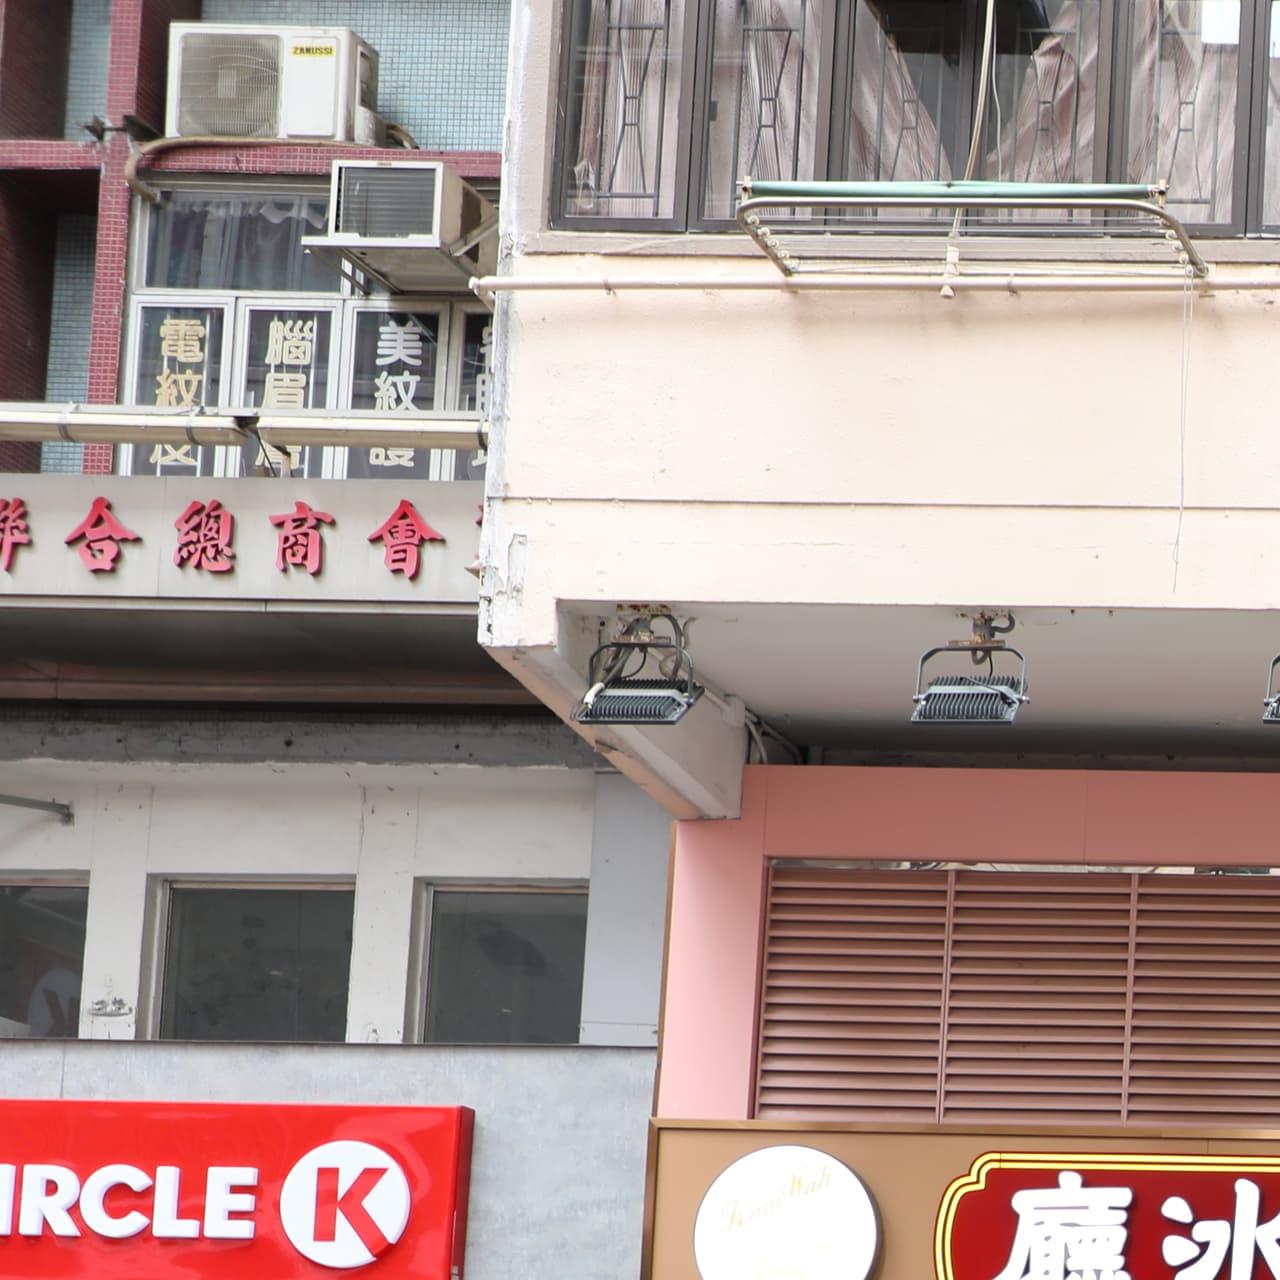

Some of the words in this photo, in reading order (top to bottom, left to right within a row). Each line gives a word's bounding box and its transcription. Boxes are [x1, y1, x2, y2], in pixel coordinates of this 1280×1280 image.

[292, 46, 334, 56] ZANUSSI
[159, 318, 493, 366] 電腦美
[312, 1165, 396, 1262] K
